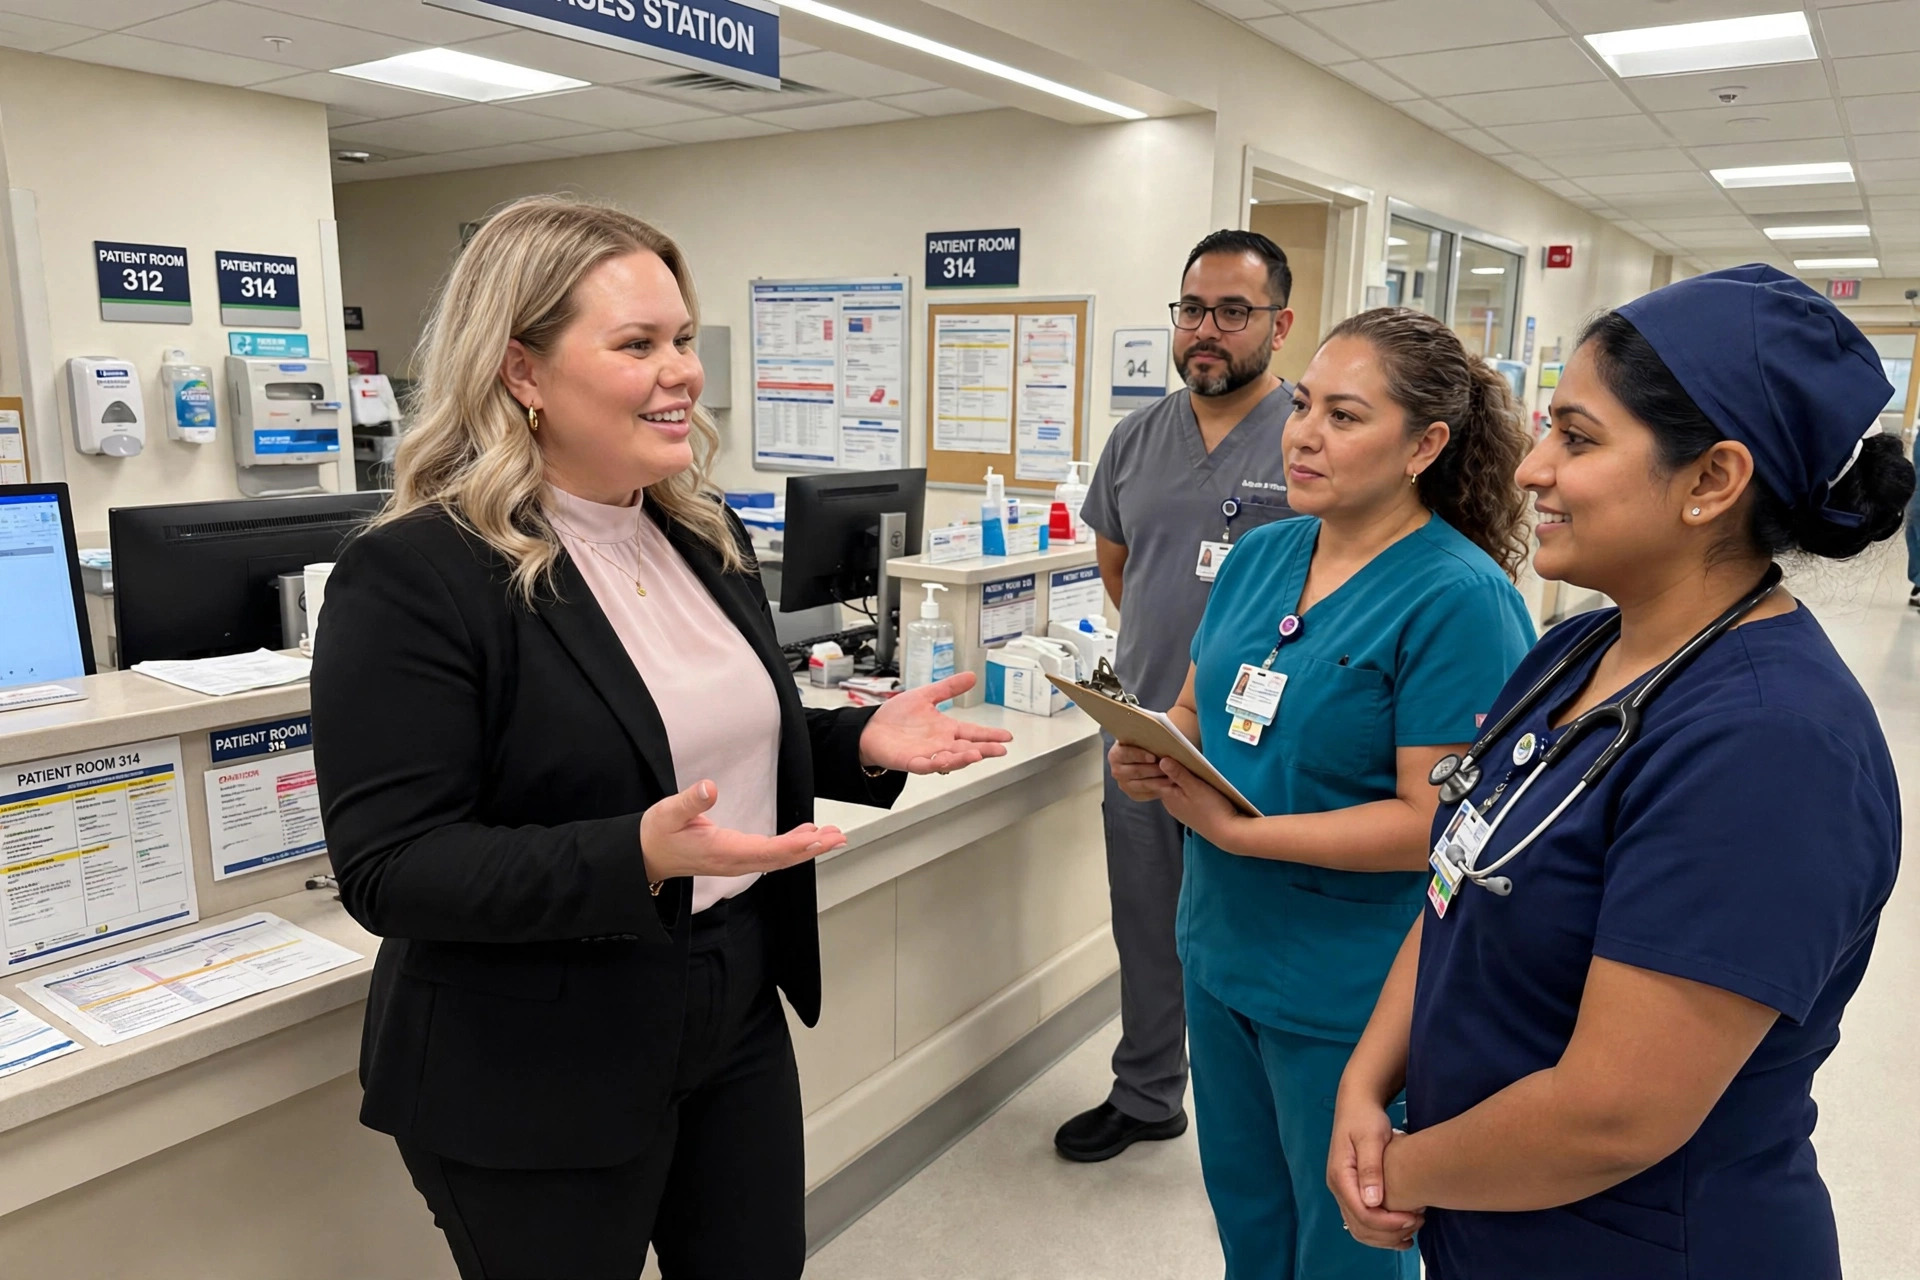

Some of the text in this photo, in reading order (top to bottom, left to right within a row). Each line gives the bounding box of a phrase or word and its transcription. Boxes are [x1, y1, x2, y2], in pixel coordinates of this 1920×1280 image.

[557, 0, 755, 55] ES STATION
[928, 237, 1016, 254] PATIENT ROOM
[99, 250, 184, 267] PATIENT ROOM
[220, 259, 295, 275] PATIENT ROOM
[943, 257, 976, 279] 314
[122, 269, 164, 292] 312
[241, 276, 277, 299] 314
[215, 731, 267, 751] PATIENT
[269, 724, 307, 740] ROOM
[268, 741, 286, 752] 314
[17, 765, 72, 787] PATIENT
[75, 757, 116, 776] ROOM
[118, 752, 141, 767] 314
